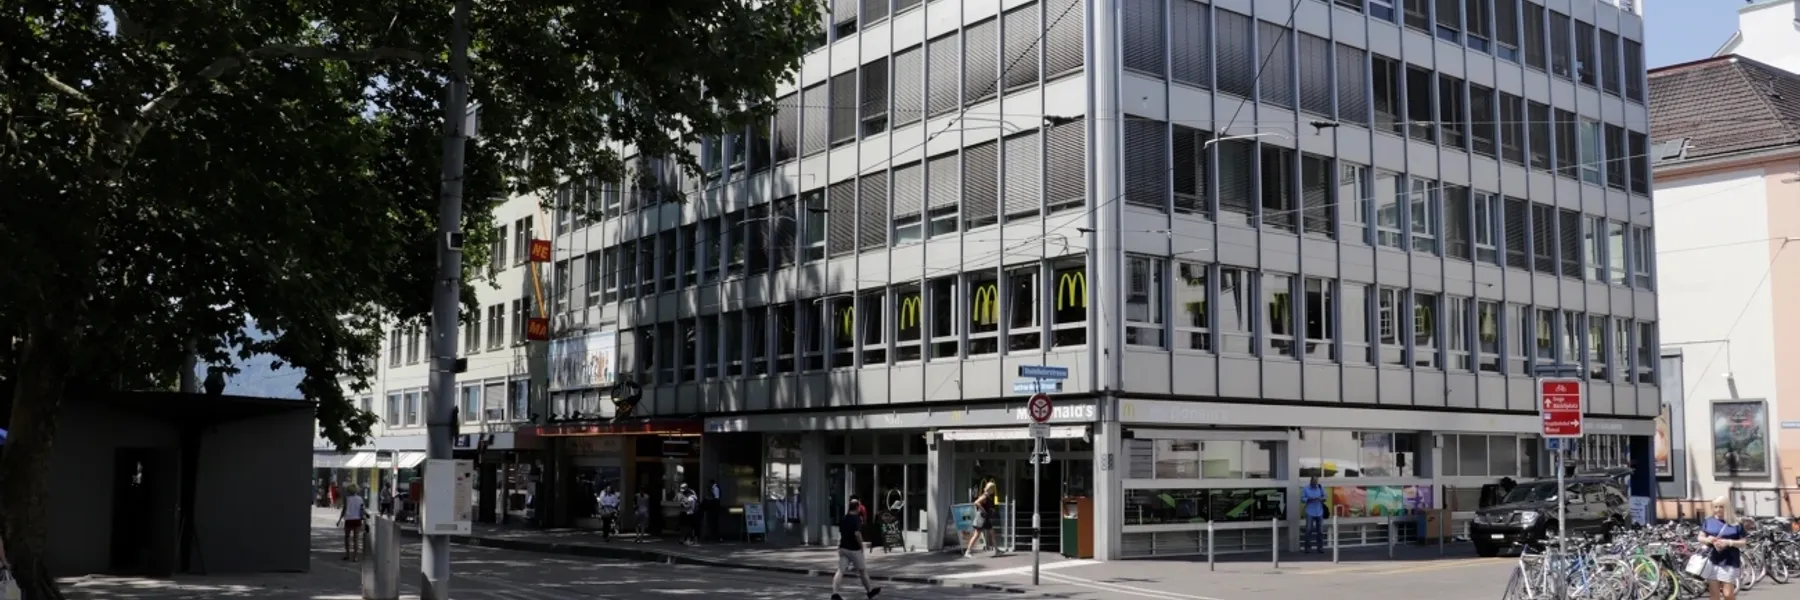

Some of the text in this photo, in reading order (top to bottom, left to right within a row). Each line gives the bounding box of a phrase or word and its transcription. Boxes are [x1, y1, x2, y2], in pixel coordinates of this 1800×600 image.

[532, 243, 549, 260] NE
[528, 321, 547, 337] MA
[1016, 404, 1094, 420] Mnald's
